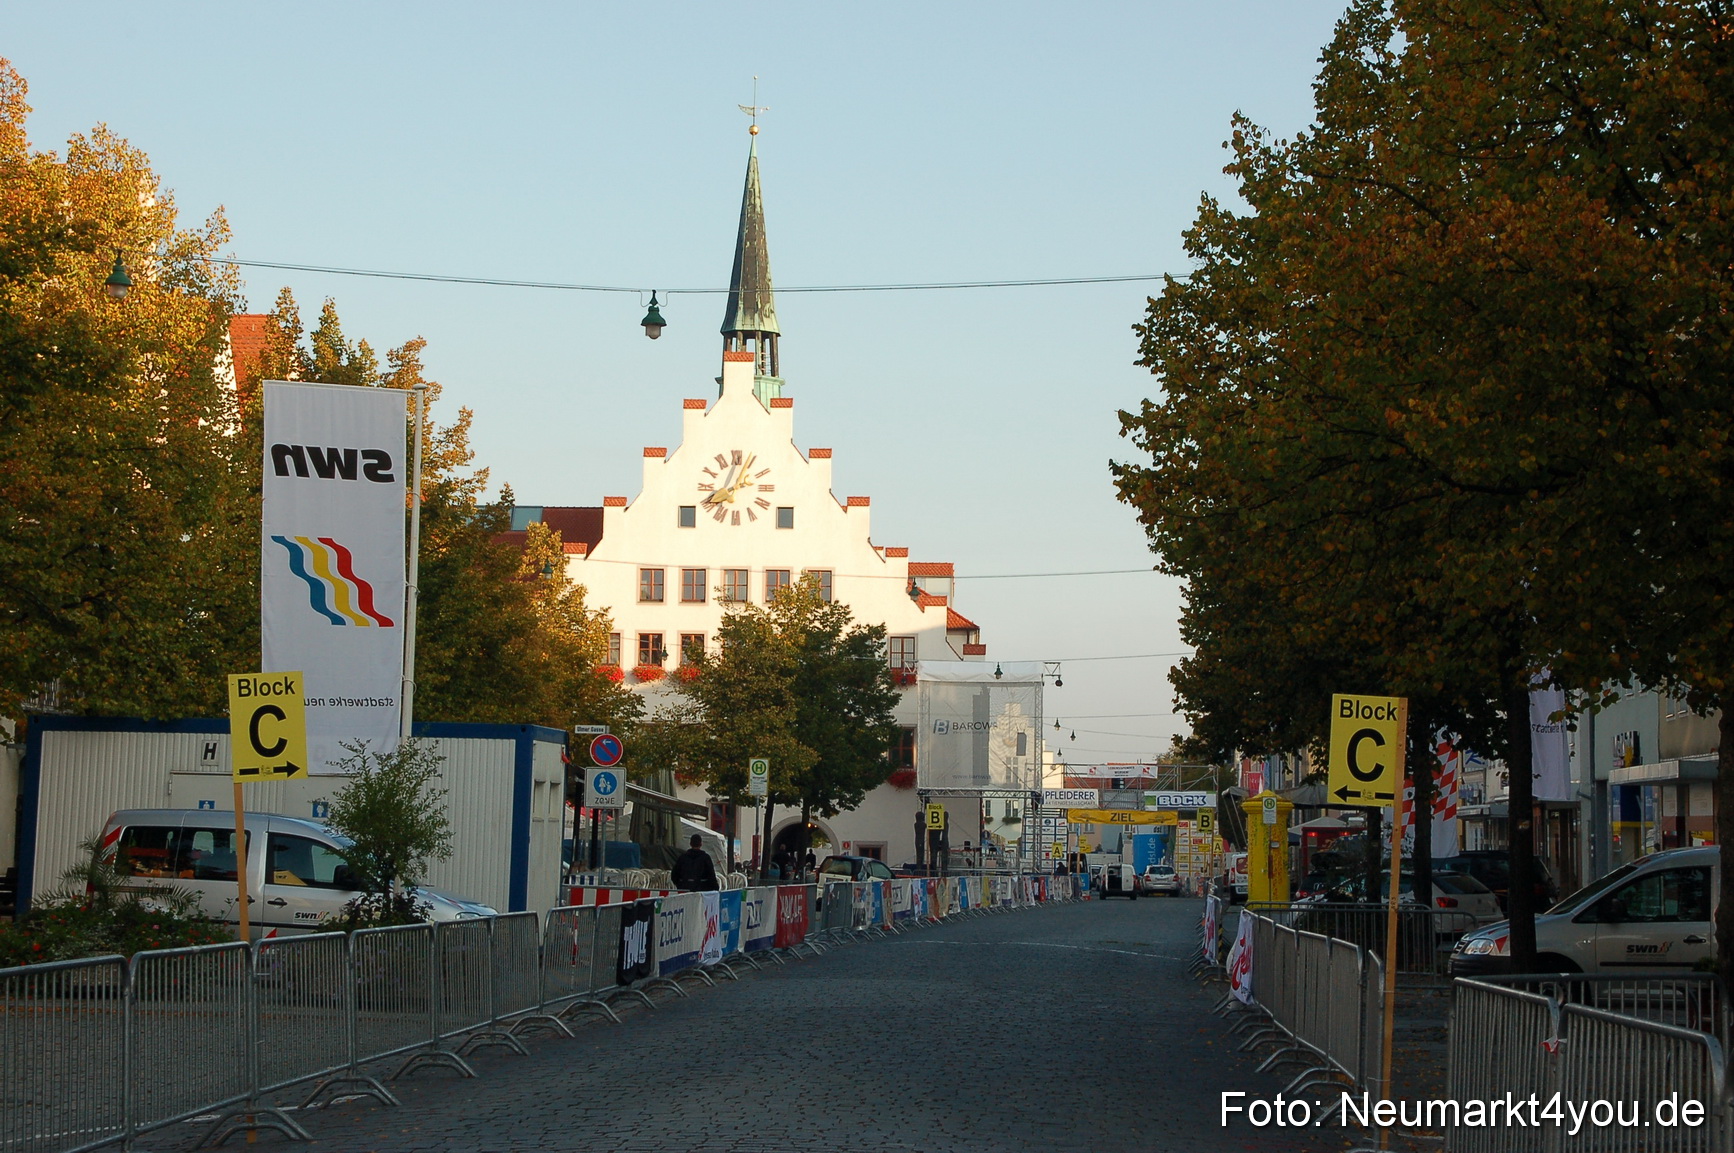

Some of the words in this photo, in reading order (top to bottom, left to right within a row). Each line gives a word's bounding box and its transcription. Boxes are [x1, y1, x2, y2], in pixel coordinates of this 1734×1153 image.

[238, 676, 296, 698] Block
[1340, 698, 1398, 721] Block
[249, 704, 288, 758] C
[204, 743, 218, 760] H
[1347, 728, 1386, 782] C
[595, 797, 615, 805] ZONE
[1045, 791, 1095, 800] PFLEIDERER
[1157, 795, 1207, 806] BOCK
[931, 811, 940, 824] B
[1110, 812, 1135, 823] ZIEL
[1201, 815, 1210, 828] B
[1053, 847, 1061, 855] A
[1214, 842, 1222, 851] A
[295, 912, 317, 920] swn
[1626, 944, 1658, 953] swn
